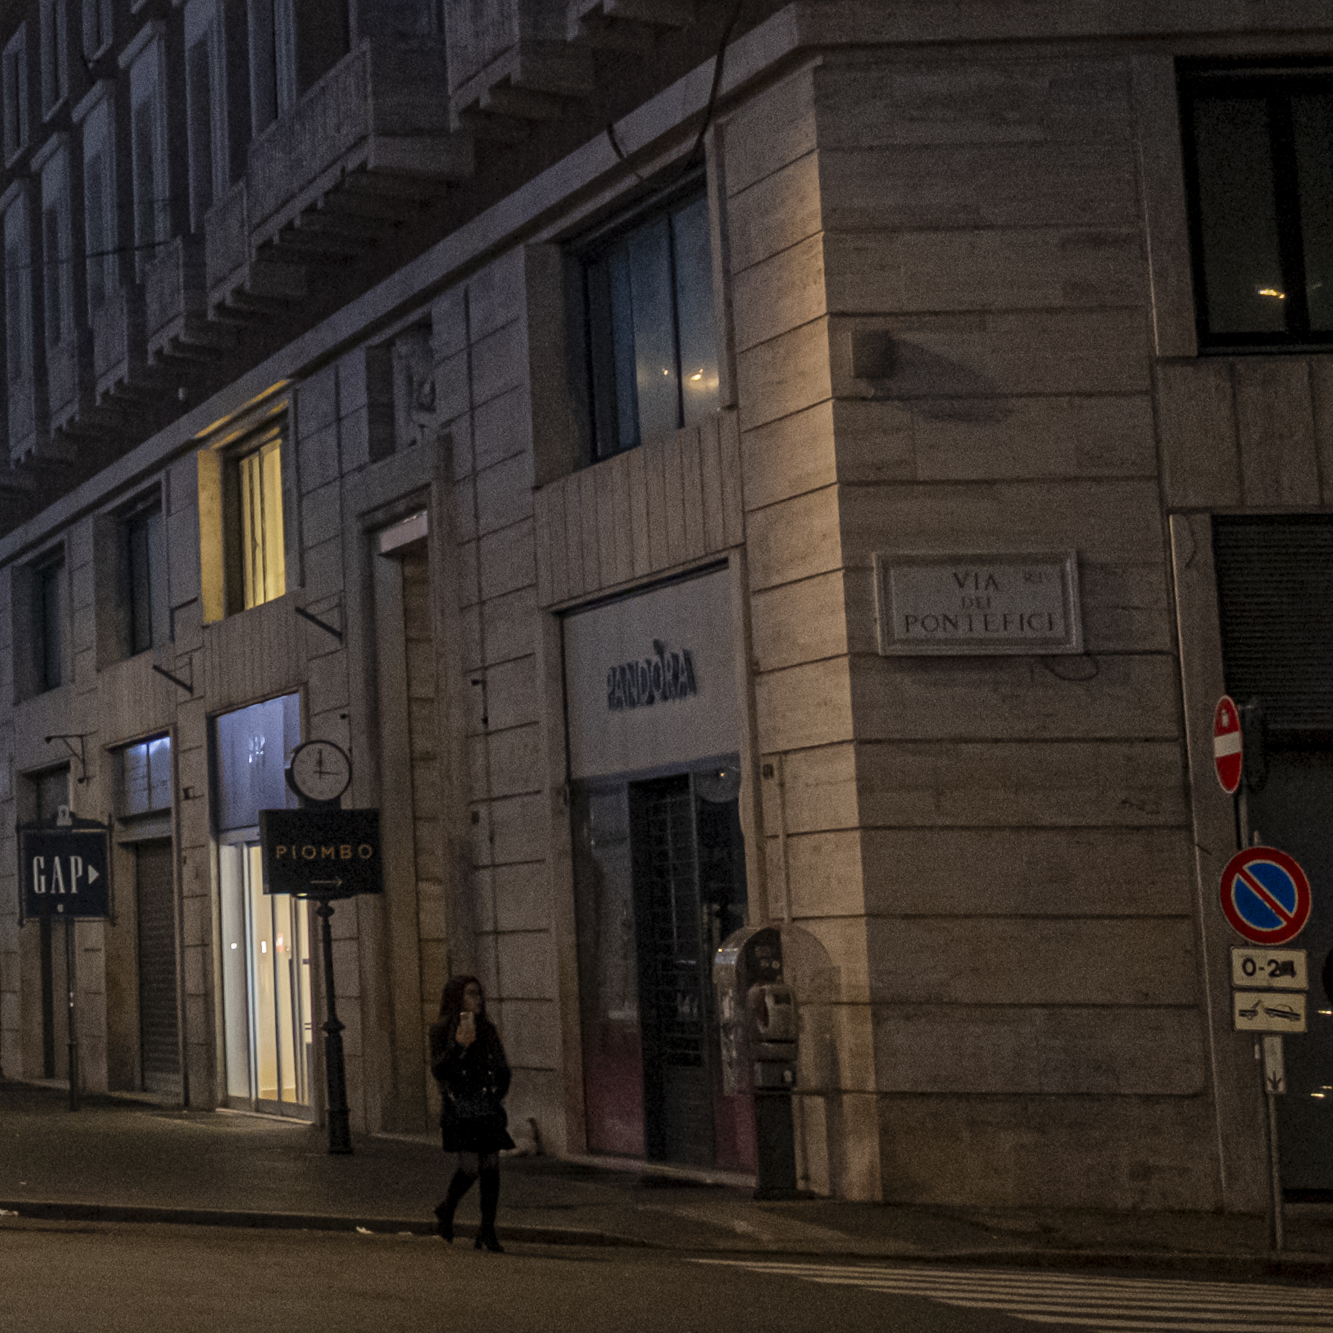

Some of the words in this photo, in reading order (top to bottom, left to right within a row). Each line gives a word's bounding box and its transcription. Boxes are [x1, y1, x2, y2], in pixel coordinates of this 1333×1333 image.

[953, 572, 1000, 591] VIA
[961, 597, 992, 610] DEI
[904, 612, 1054, 633] PONTEFICI
[275, 844, 373, 860] PIOMBO
[32, 855, 84, 895] GAP
